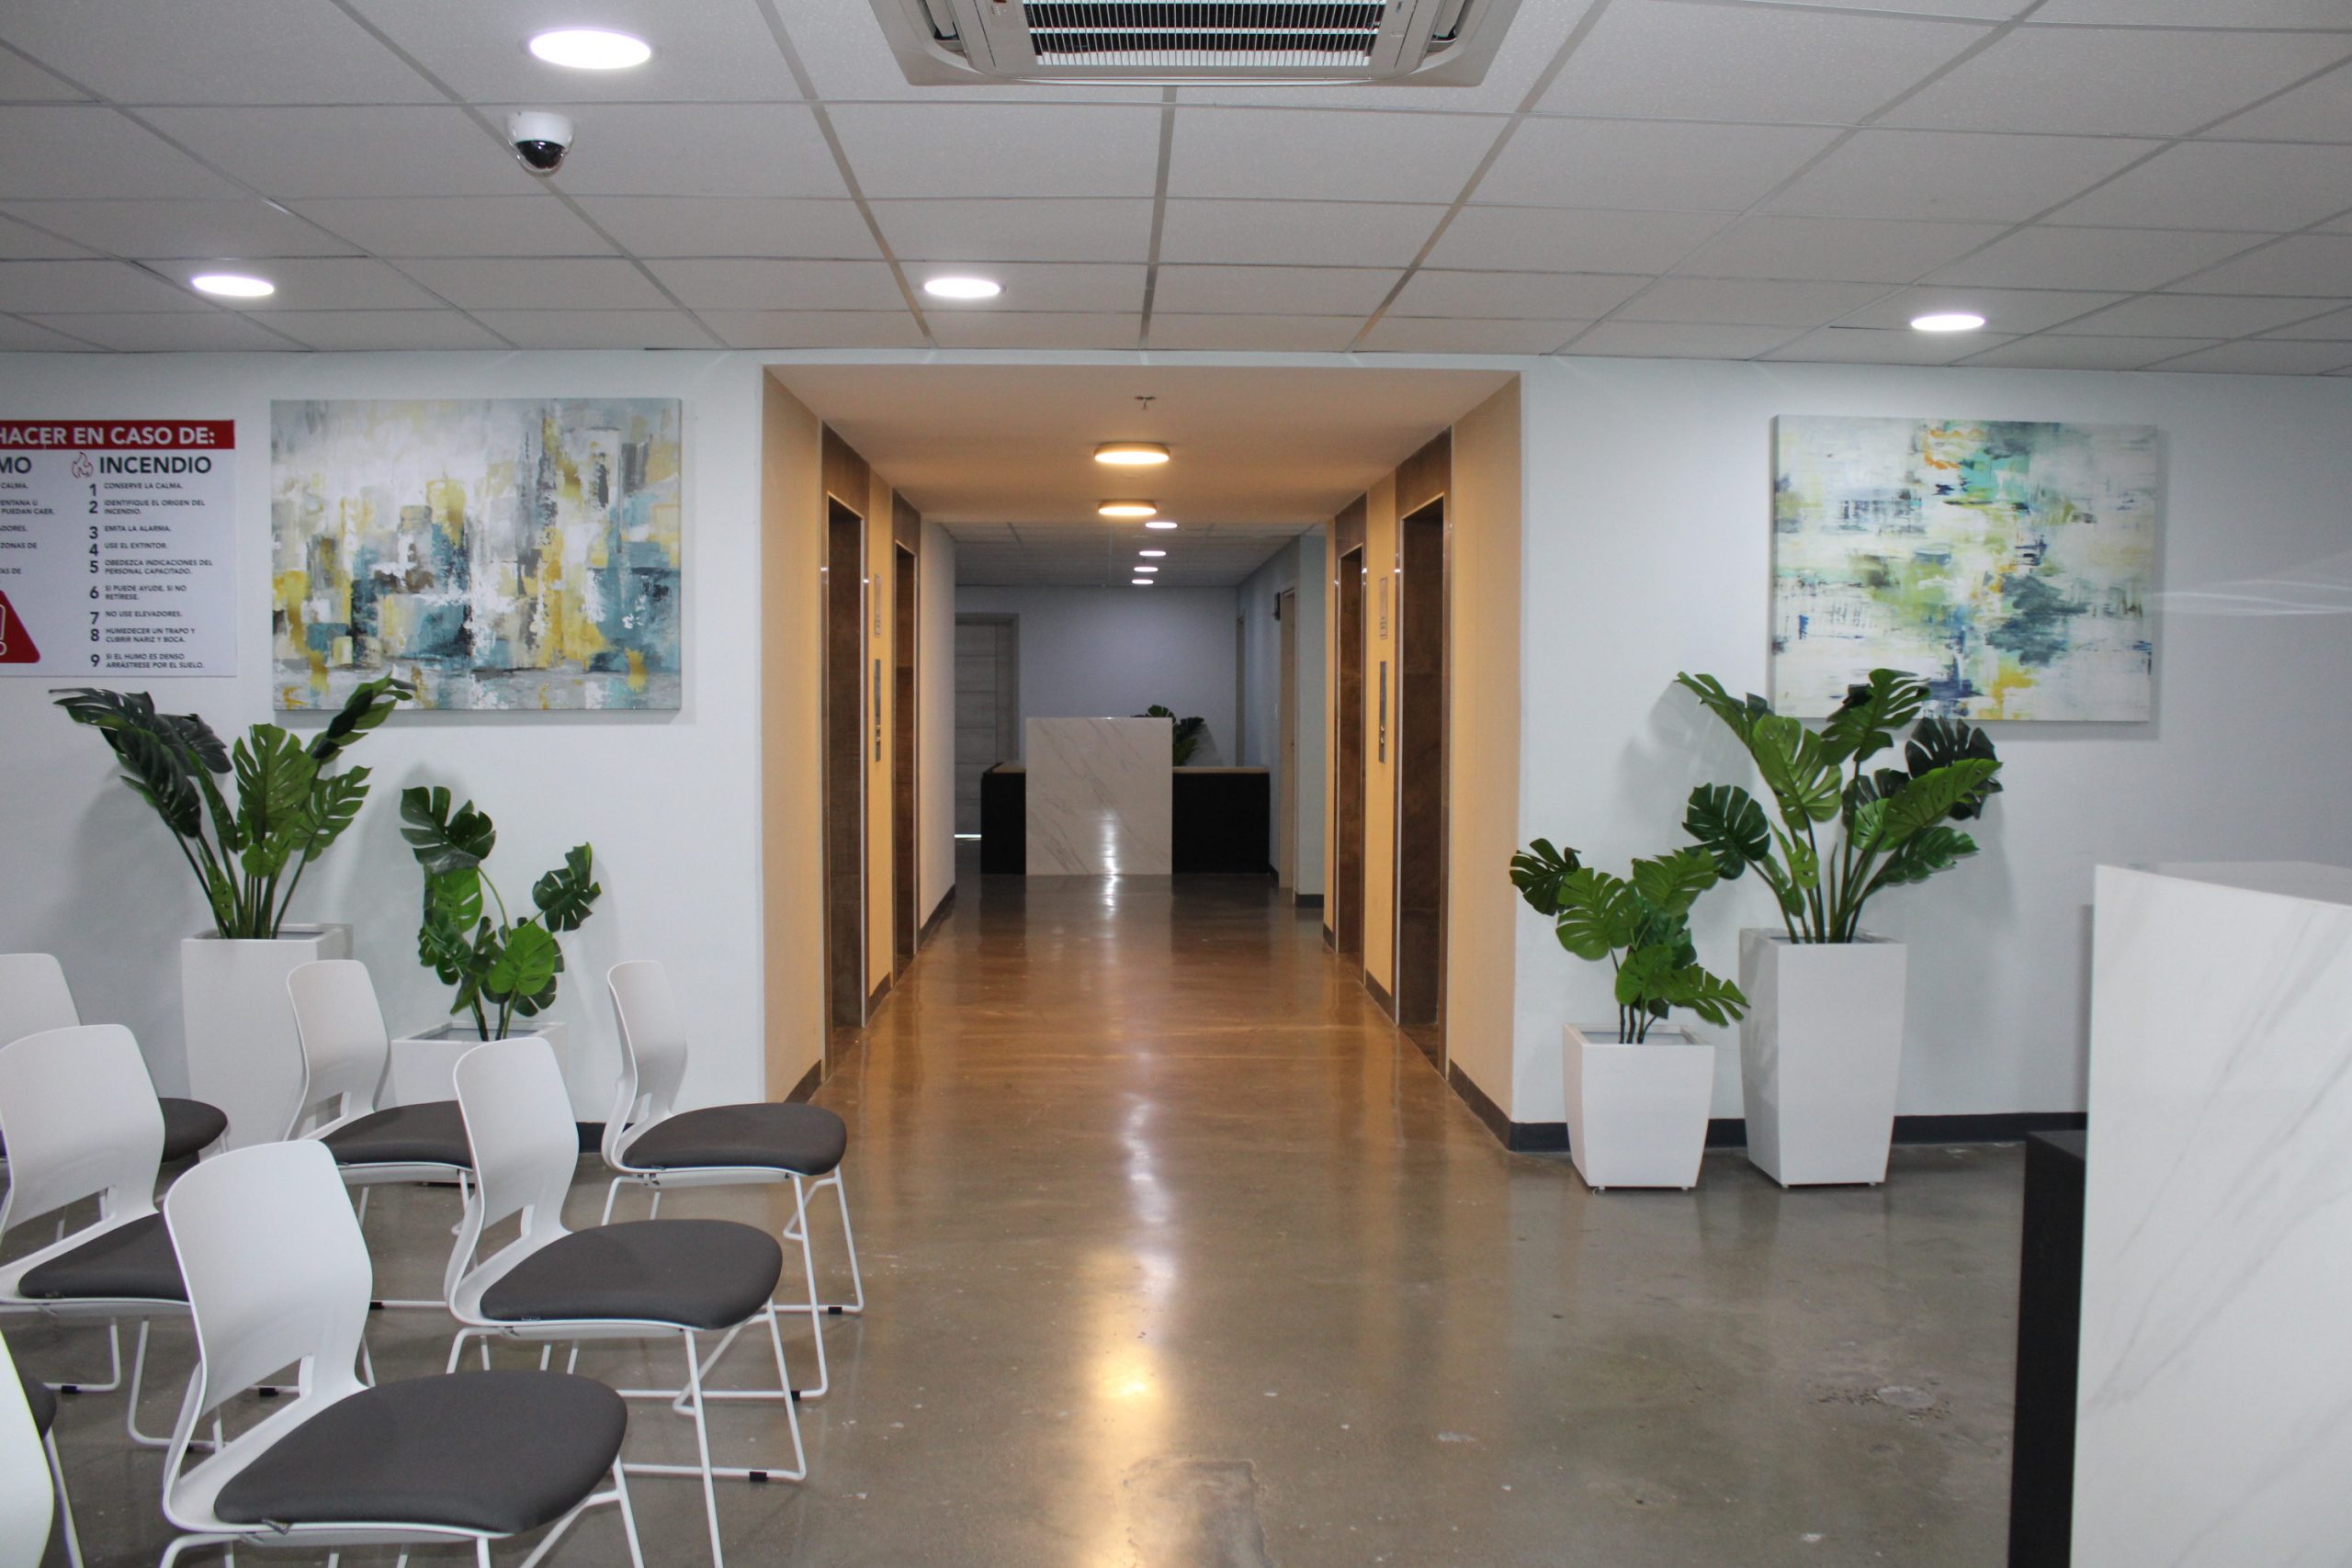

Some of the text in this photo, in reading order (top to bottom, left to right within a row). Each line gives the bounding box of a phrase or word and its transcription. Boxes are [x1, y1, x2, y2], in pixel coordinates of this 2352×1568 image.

[73, 426, 104, 446] EN
[110, 426, 173, 446] CASO
[179, 426, 215, 446] DE:
[99, 457, 211, 474] INCENDIO
[89, 483, 97, 496] 1
[89, 501, 98, 513] 2
[89, 526, 98, 539] 3
[89, 543, 99, 557] 4
[90, 560, 98, 573] 5
[90, 586, 99, 599] 6
[90, 612, 99, 625] 7
[90, 628, 99, 642] 8
[90, 654, 100, 667] 9
